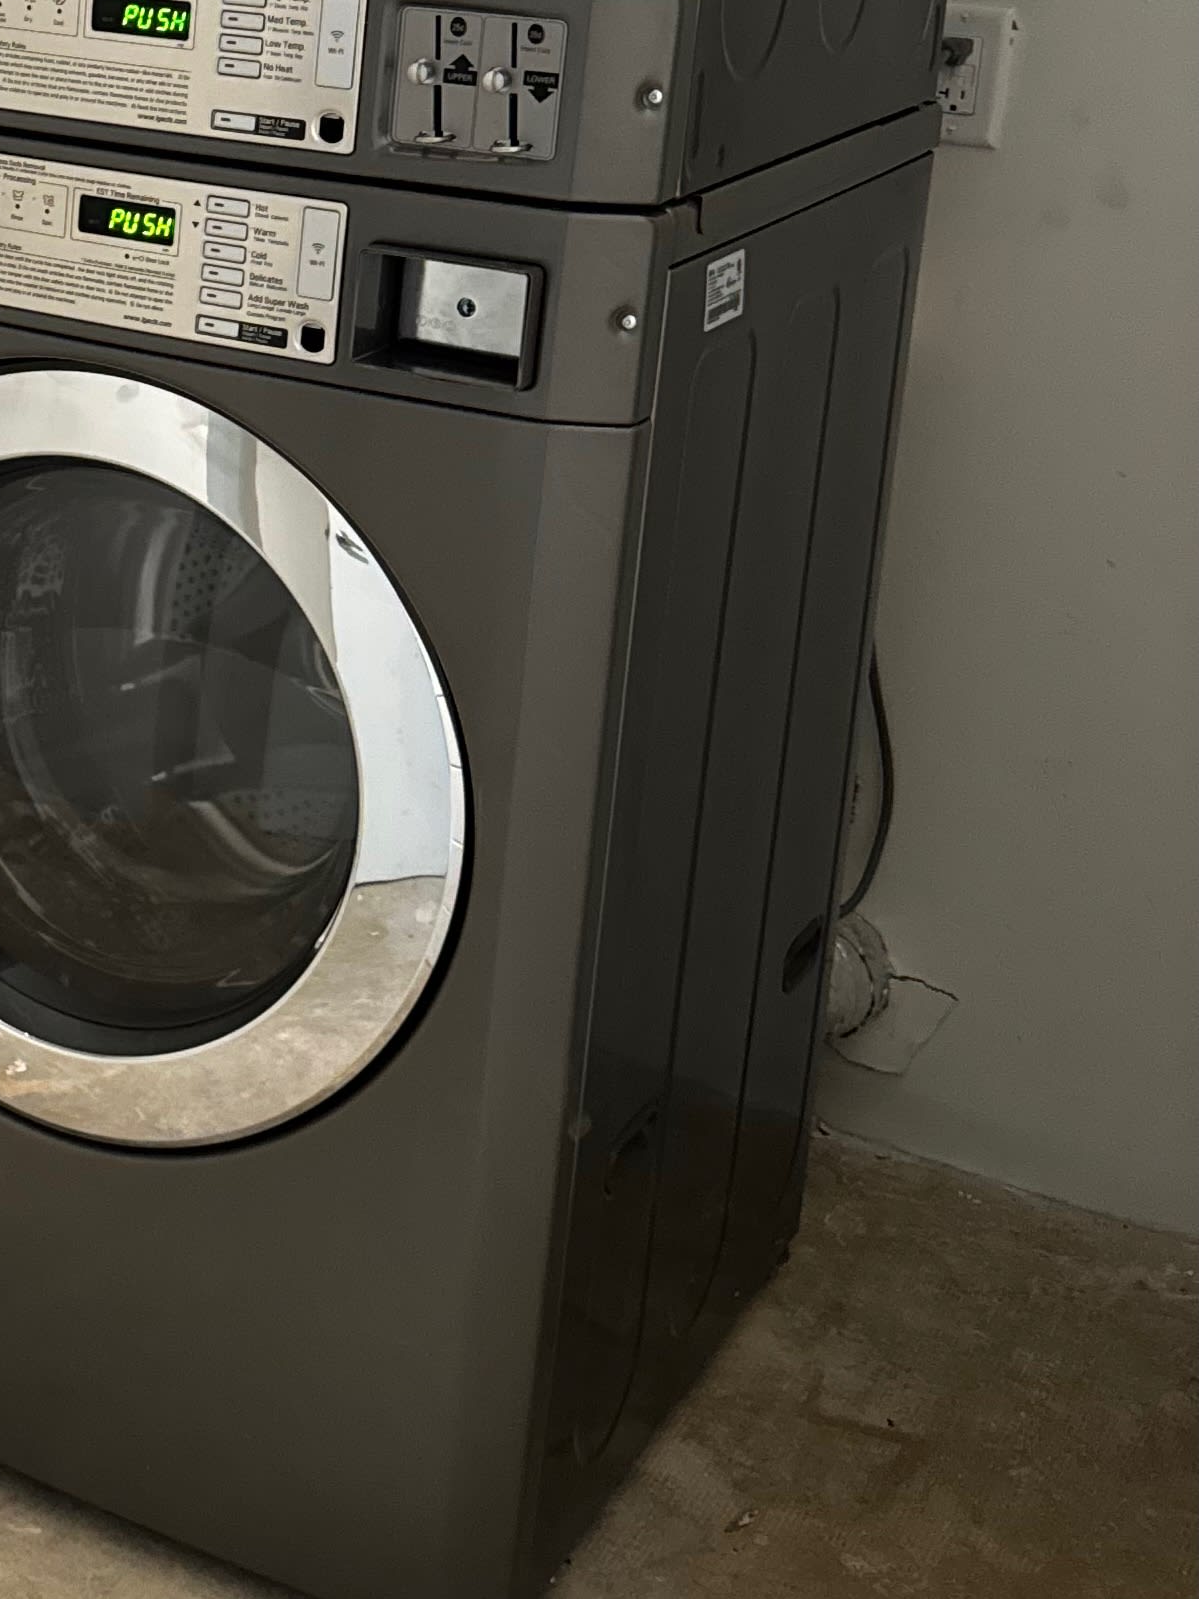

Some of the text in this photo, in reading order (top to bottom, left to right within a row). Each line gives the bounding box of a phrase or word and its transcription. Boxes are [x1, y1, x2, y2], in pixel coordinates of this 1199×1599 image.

[122, 4, 187, 32] PUSH
[263, 63, 293, 74] No Heat
[447, 72, 473, 82] UPPER
[527, 75, 555, 84] LOWER
[3, 173, 36, 185] Processing
[110, 190, 125, 199] Time
[127, 191, 160, 205] Remaining
[255, 204, 269, 212] Hot
[108, 208, 173, 237] PUSH
[253, 228, 277, 237] Warm
[251, 250, 267, 260] Cold
[249, 273, 283, 285] Delicates
[248, 294, 263, 303] Add
[264, 296, 286, 307] Super
[287, 301, 309, 311] Wash
